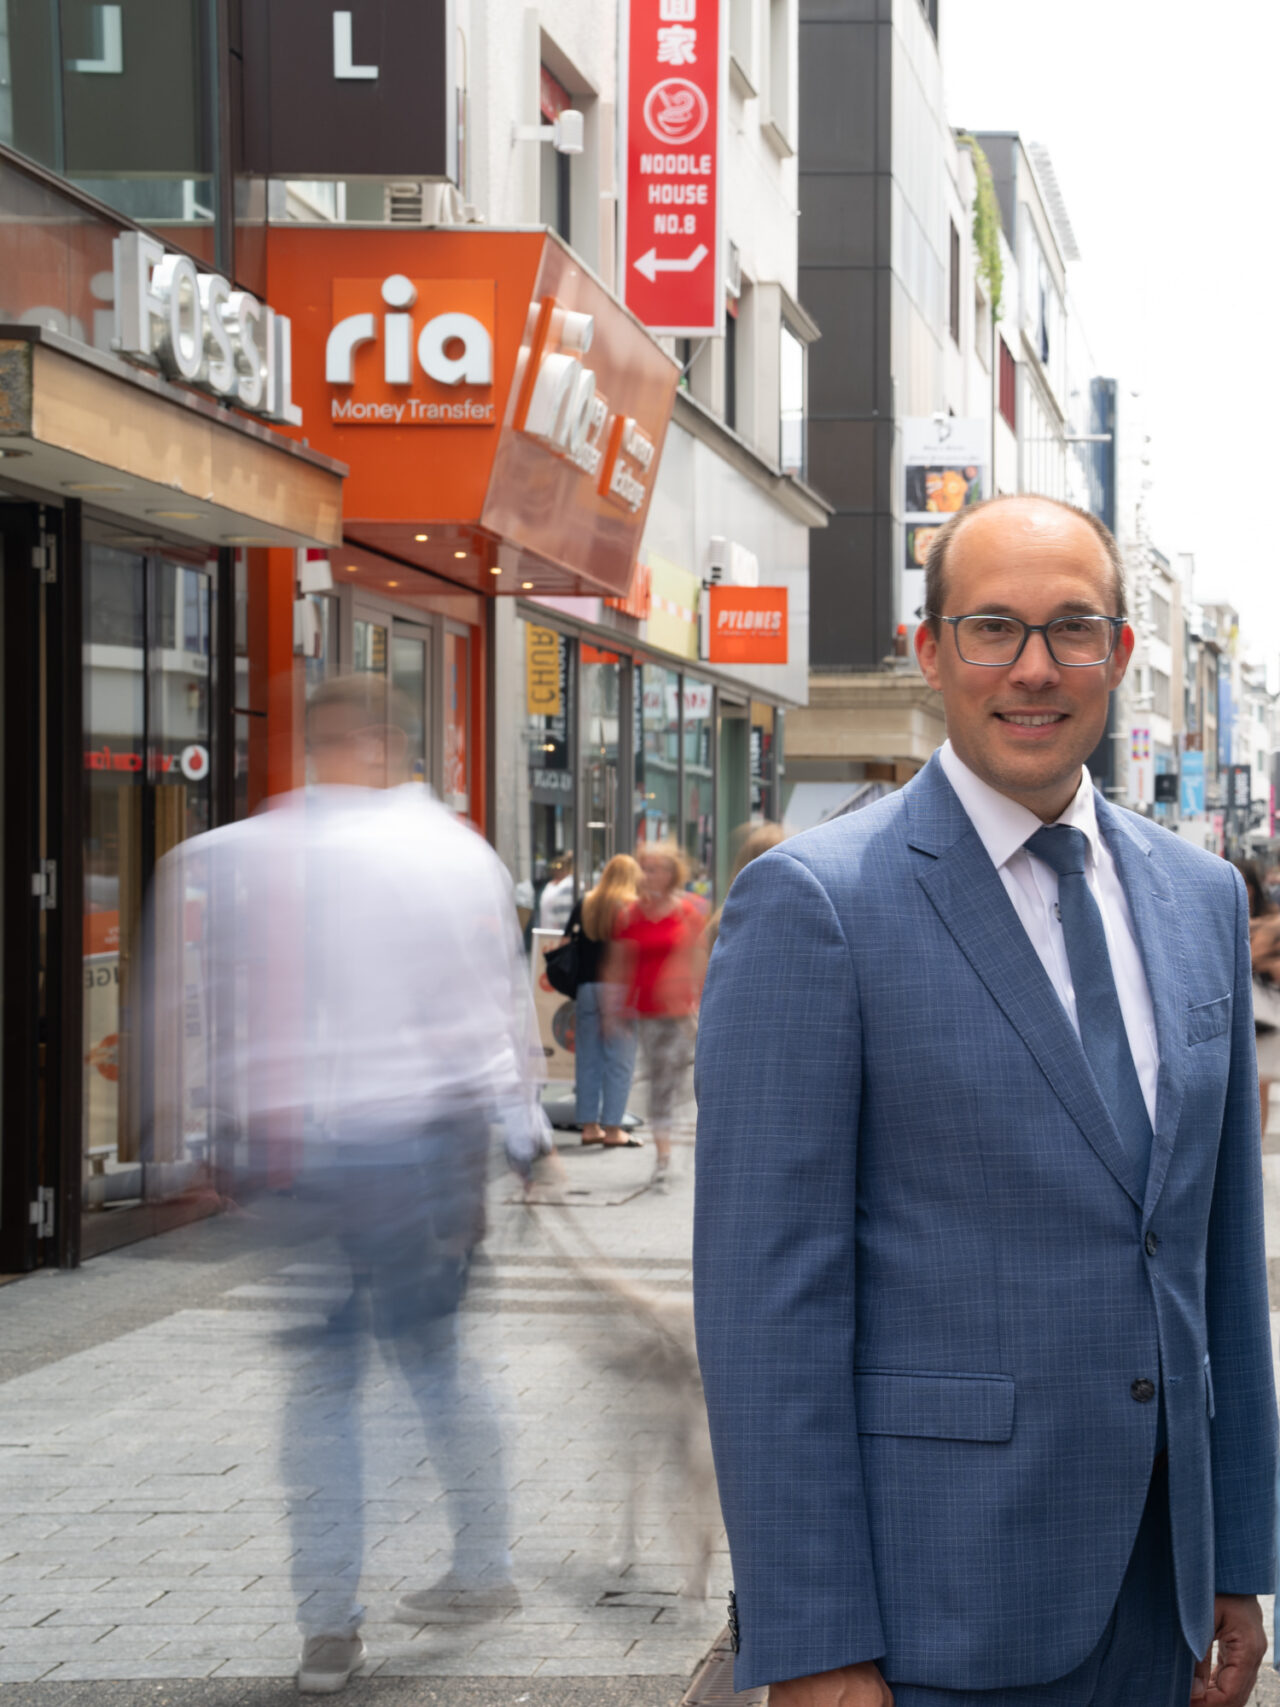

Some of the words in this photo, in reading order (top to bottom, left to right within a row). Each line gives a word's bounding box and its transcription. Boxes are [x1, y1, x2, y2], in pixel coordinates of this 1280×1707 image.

[640, 153, 712, 175] NOODLE
[648, 184, 708, 205] HOUSE
[653, 214, 697, 235] NO.8
[119, 231, 303, 427] FOSSIL
[325, 274, 494, 386] ria
[331, 398, 405, 424] Money
[407, 398, 494, 420] Transfer
[717, 609, 783, 630] PYLONES
